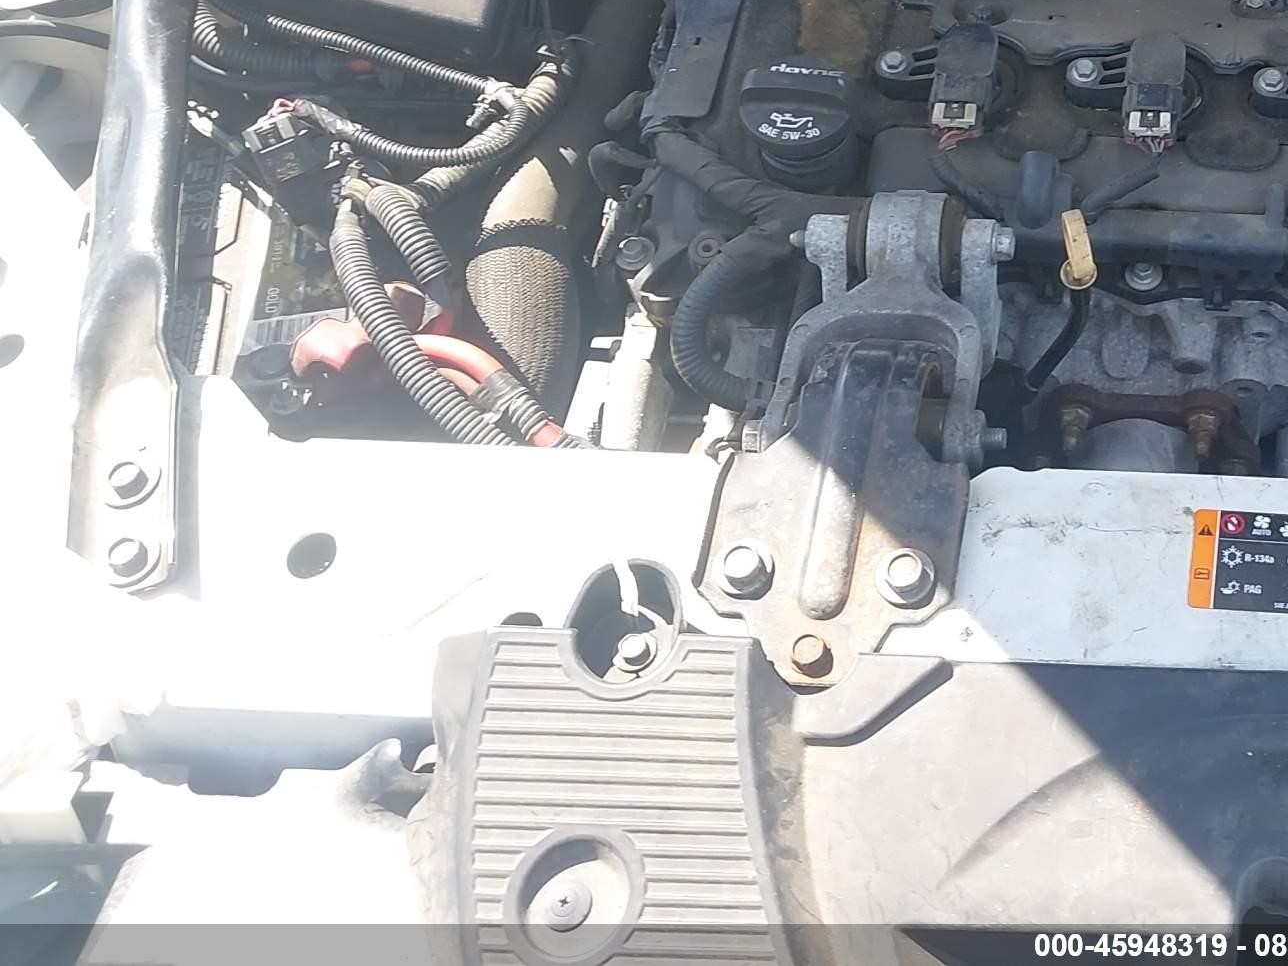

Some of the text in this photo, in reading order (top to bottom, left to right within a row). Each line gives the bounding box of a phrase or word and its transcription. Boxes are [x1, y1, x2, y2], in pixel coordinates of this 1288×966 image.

[758, 123, 821, 140] SAE 5W-30
[1244, 553, 1275, 564] R-134a
[1243, 584, 1262, 594] PAG
